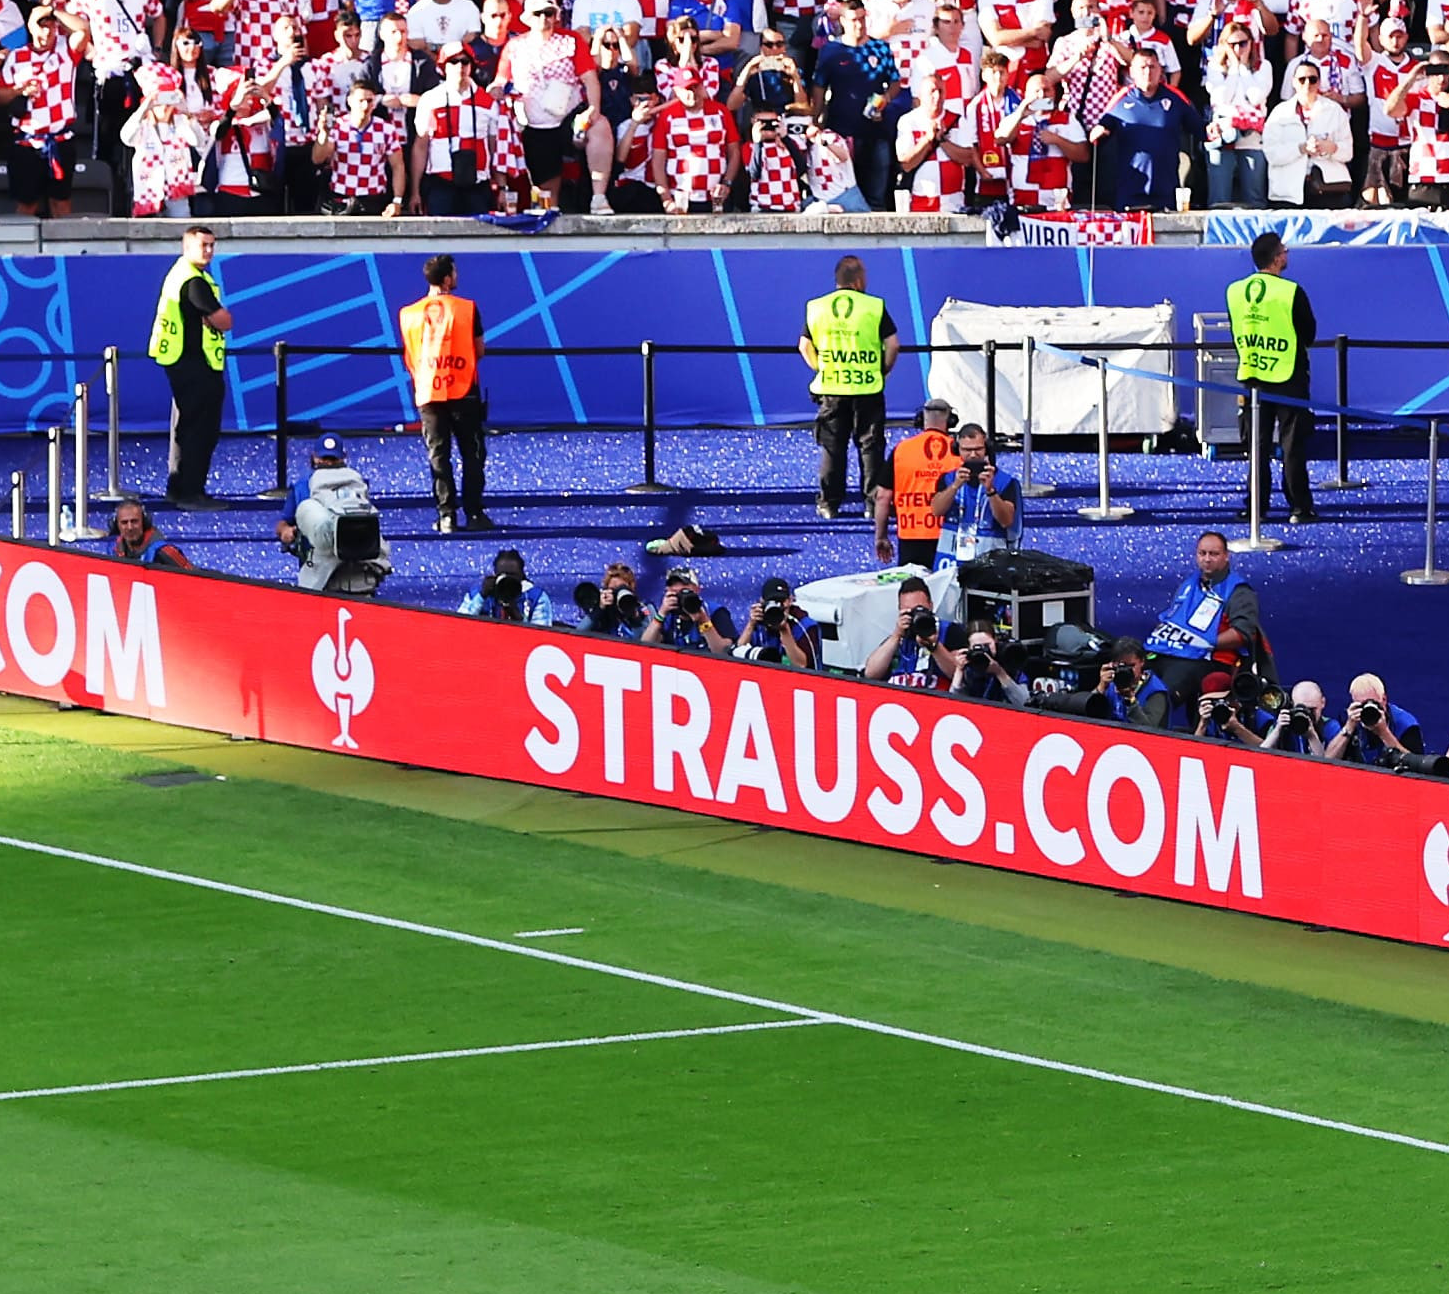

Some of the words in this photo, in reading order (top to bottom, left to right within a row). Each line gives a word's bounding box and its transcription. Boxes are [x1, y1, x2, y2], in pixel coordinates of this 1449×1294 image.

[1239, 335, 1289, 353] EWARD
[820, 349, 876, 364] EWARD
[820, 369, 874, 384] 1-1338
[896, 492, 935, 508] STEW
[900, 514, 944, 531] 01-0
[523, 644, 1264, 899] STRAUSS.COM
